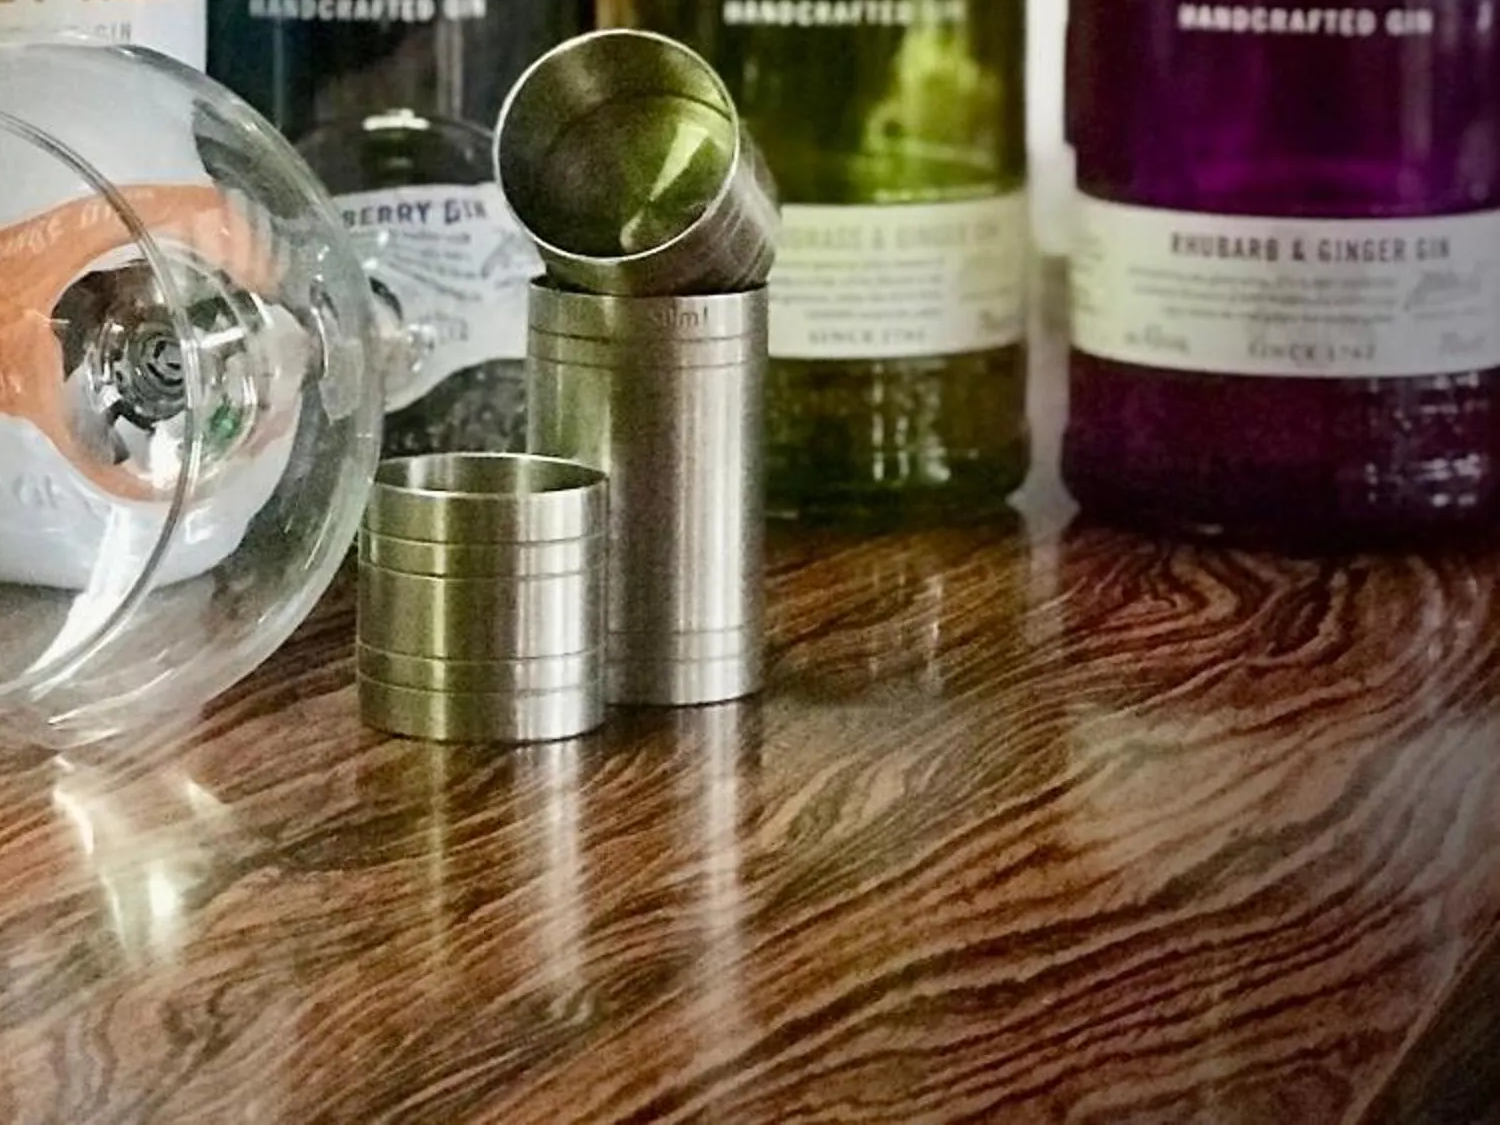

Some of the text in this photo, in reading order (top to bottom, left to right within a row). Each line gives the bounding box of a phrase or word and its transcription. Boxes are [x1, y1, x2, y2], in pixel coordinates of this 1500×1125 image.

[1178, 2, 1433, 36] HANDCRAFTED GIN
[1171, 232, 1280, 263] RHUBARB
[1317, 239, 1406, 263] GINGER
[1415, 236, 1451, 259] GIN
